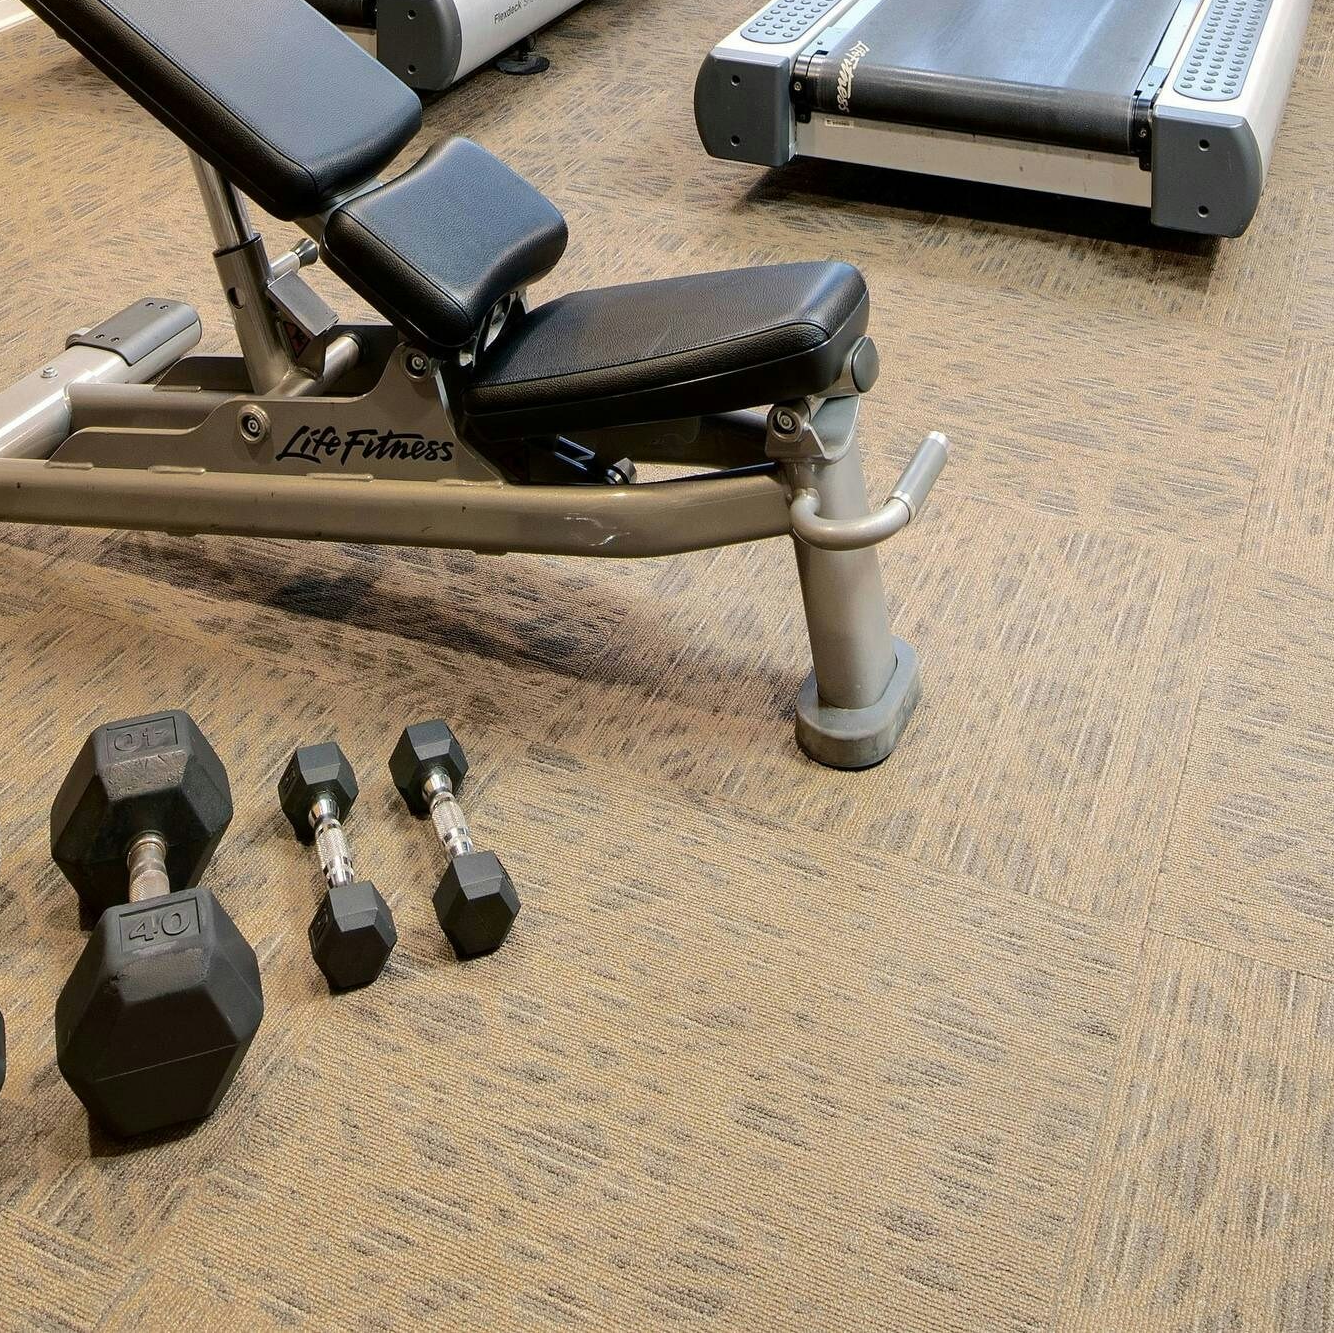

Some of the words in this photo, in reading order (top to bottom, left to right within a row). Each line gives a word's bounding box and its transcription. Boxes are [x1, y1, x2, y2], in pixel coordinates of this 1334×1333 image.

[493, 0, 522, 25] Flexdeck
[274, 424, 342, 464] Life
[340, 428, 455, 466] Fitness
[128, 912, 191, 942] 40
